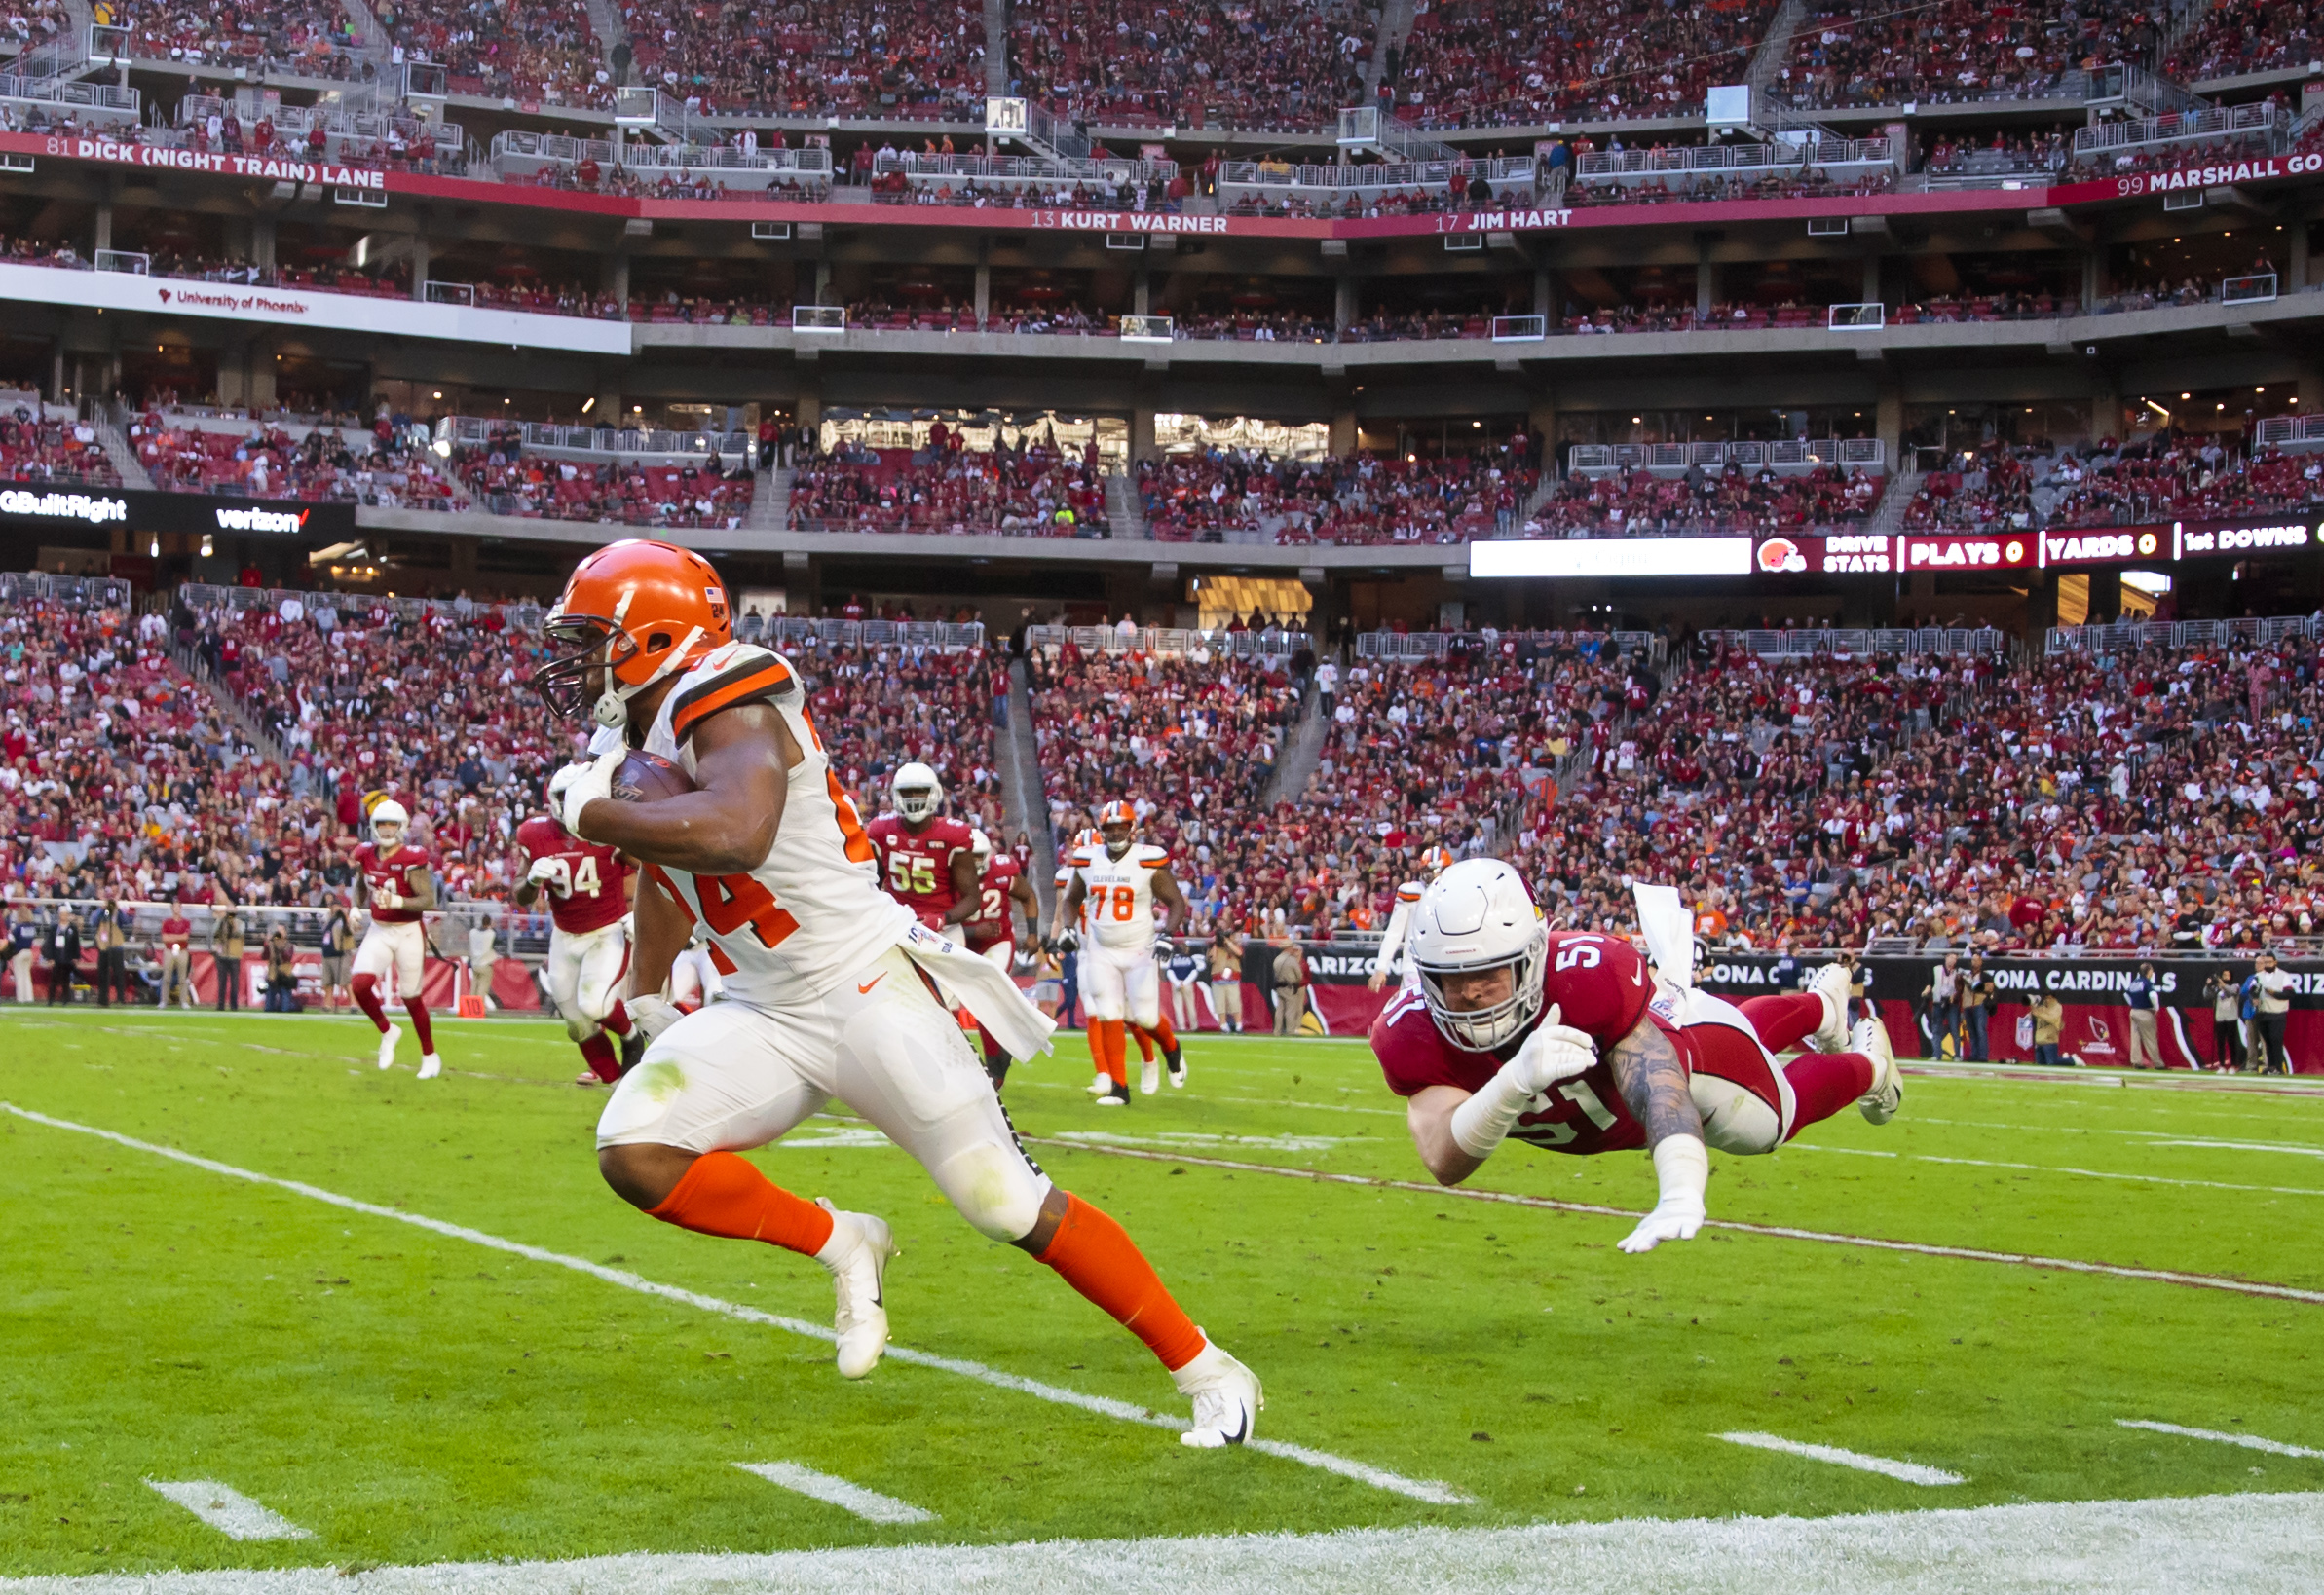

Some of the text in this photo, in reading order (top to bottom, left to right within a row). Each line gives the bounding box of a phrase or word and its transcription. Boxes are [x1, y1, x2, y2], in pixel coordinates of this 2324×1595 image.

[47, 137, 384, 189] 81 DICK (NIGHT TRAIN) LANE
[2118, 153, 2322, 196] 99 MARSHALL GO
[1031, 211, 1227, 233] 13 KURT WARNER
[1435, 209, 1572, 233] 17 JIM HART
[177, 290, 304, 314] University of Phoenix
[216, 507, 300, 533] verizon
[1826, 536, 1888, 552] DRIVE
[2046, 533, 2157, 560] YARDS 0
[2184, 532, 2214, 551] 1st
[2219, 526, 2308, 549] DOWNS
[1823, 555, 1890, 573] STATS
[1910, 540, 2024, 565] PLAYS 0
[552, 856, 602, 900] 94
[888, 851, 937, 894] 55
[1093, 874, 1131, 883] CLEVELAND
[1090, 885, 1135, 922] 78
[1556, 935, 1605, 973] 51
[2045, 970, 2177, 992] CARDINLS
[466, 999, 481, 1016] 10
